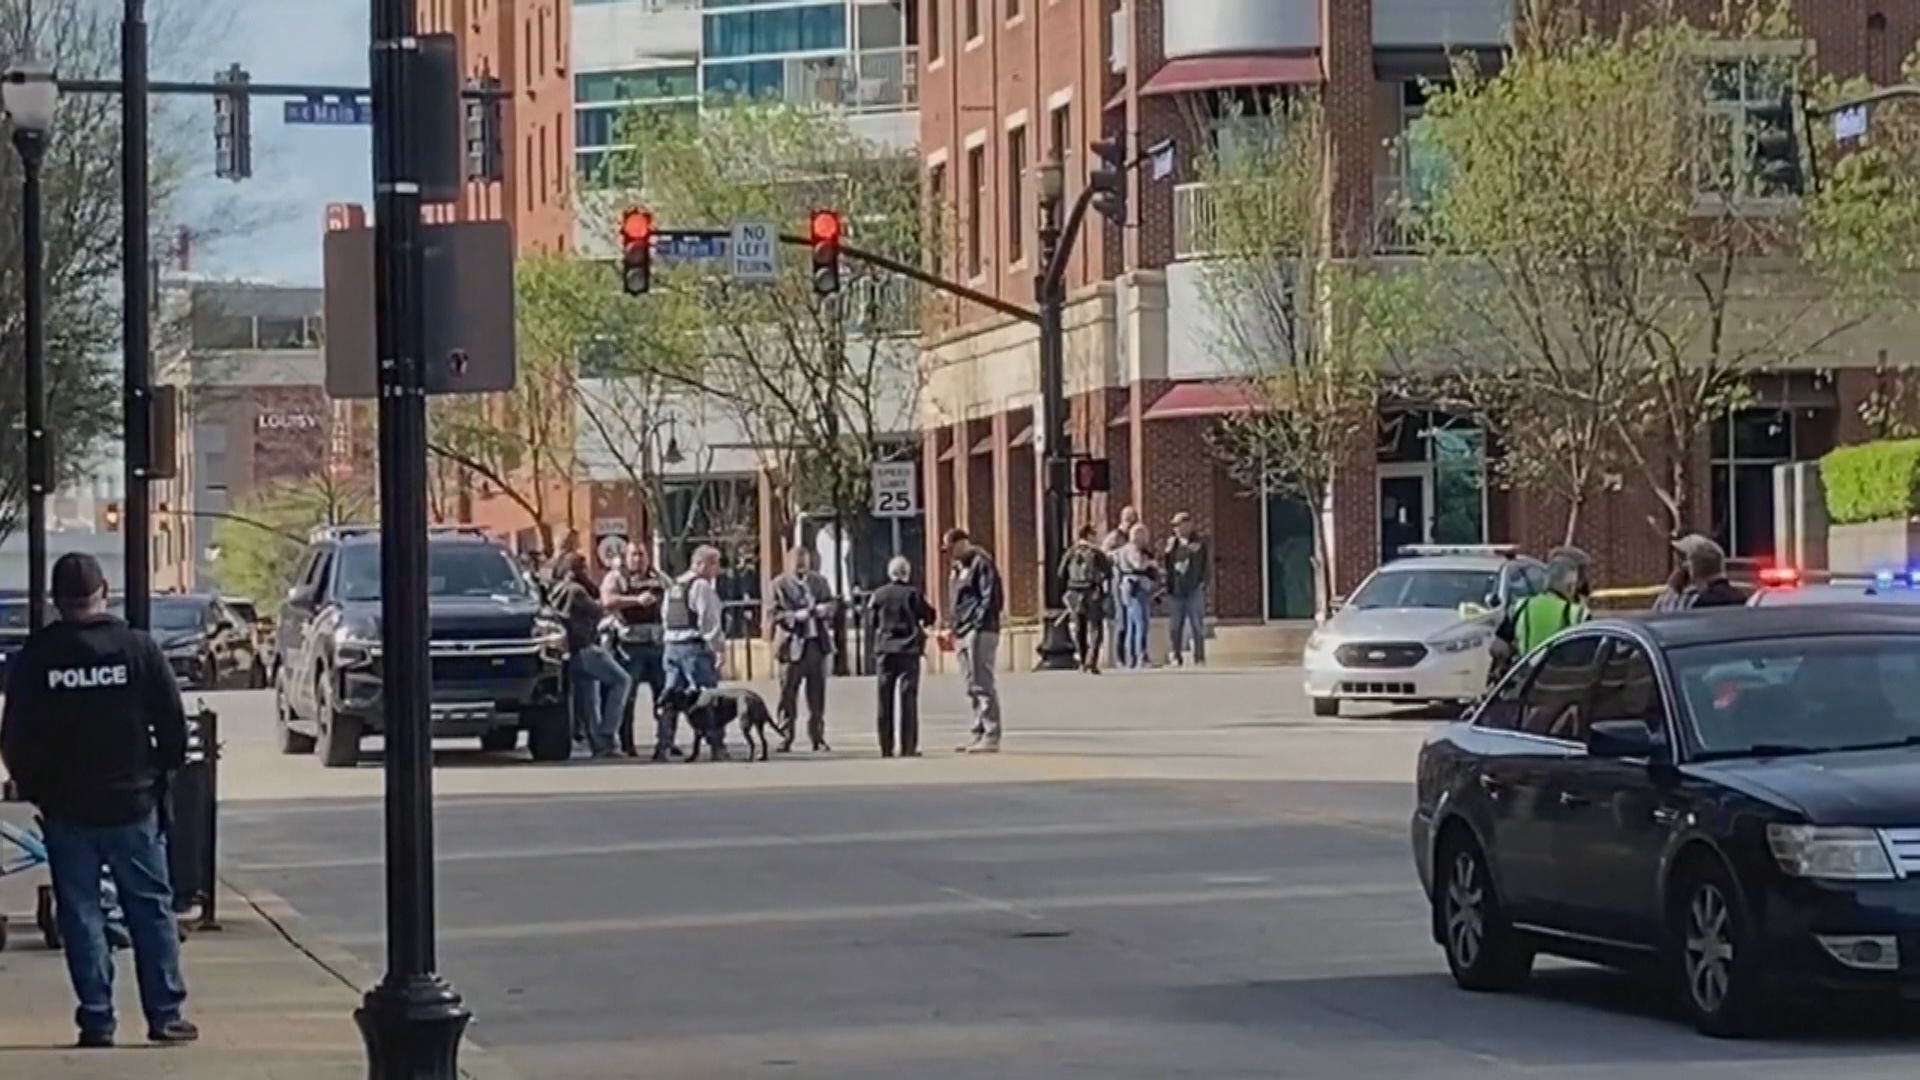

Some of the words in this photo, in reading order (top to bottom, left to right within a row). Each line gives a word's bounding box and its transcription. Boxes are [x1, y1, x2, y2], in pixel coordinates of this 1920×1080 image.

[314, 104, 355, 121] Main
[743, 225, 765, 240] NO
[737, 241, 768, 257] LEFT
[737, 260, 772, 273] TURN
[879, 491, 911, 511] 25
[48, 664, 127, 688] POLICE
